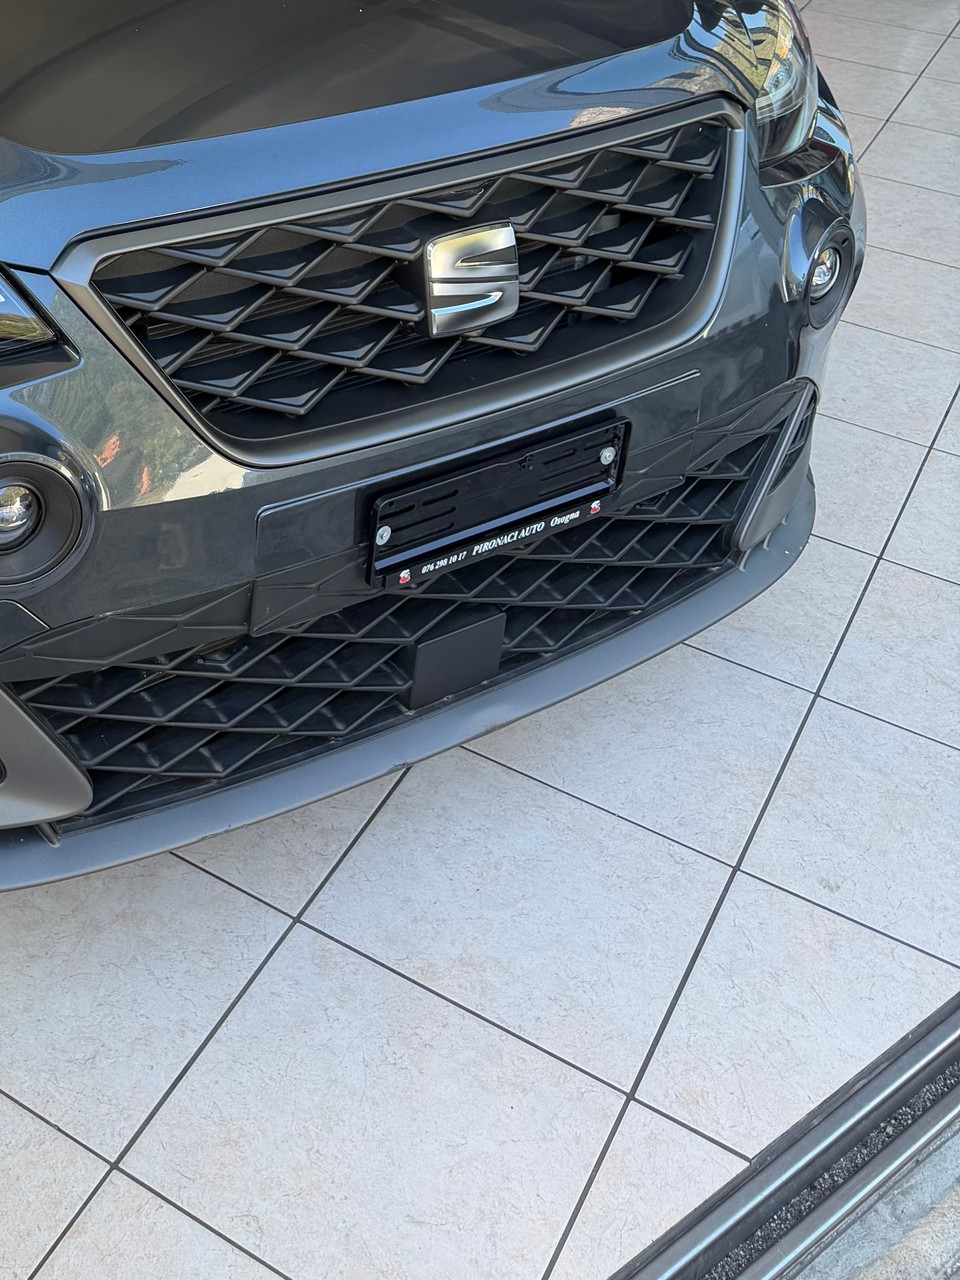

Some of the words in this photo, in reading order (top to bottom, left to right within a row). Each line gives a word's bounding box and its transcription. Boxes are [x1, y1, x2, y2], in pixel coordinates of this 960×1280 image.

[448, 554, 458, 565] 10
[457, 550, 468, 561] 17
[472, 530, 519, 556] PIRONACI
[518, 521, 546, 539] AUTO
[550, 510, 580, 527] Osogna
